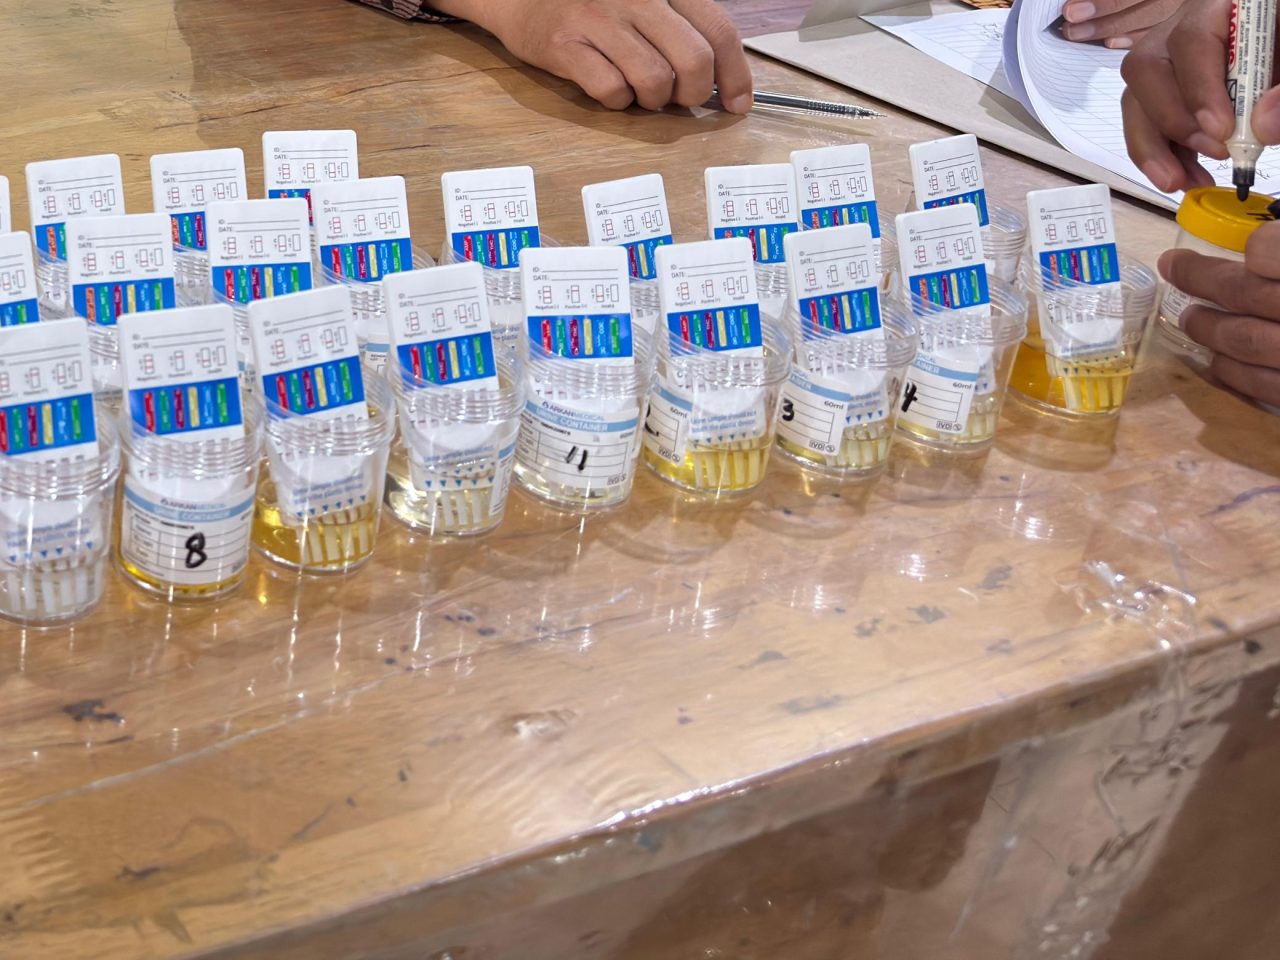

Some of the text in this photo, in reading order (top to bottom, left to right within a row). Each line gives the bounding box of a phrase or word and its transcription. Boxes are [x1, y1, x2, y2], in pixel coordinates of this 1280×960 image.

[1236, 95, 1245, 117] ROUND
[953, 381, 972, 389] 60ml
[782, 397, 795, 421] 3
[824, 400, 844, 410] 60ml
[670, 407, 688, 419] 60ml
[560, 417, 608, 432] CONTAINER
[937, 422, 952, 431] IVD
[810, 441, 825, 451] IVD
[565, 445, 588, 471] 11
[185, 532, 208, 569] 8
